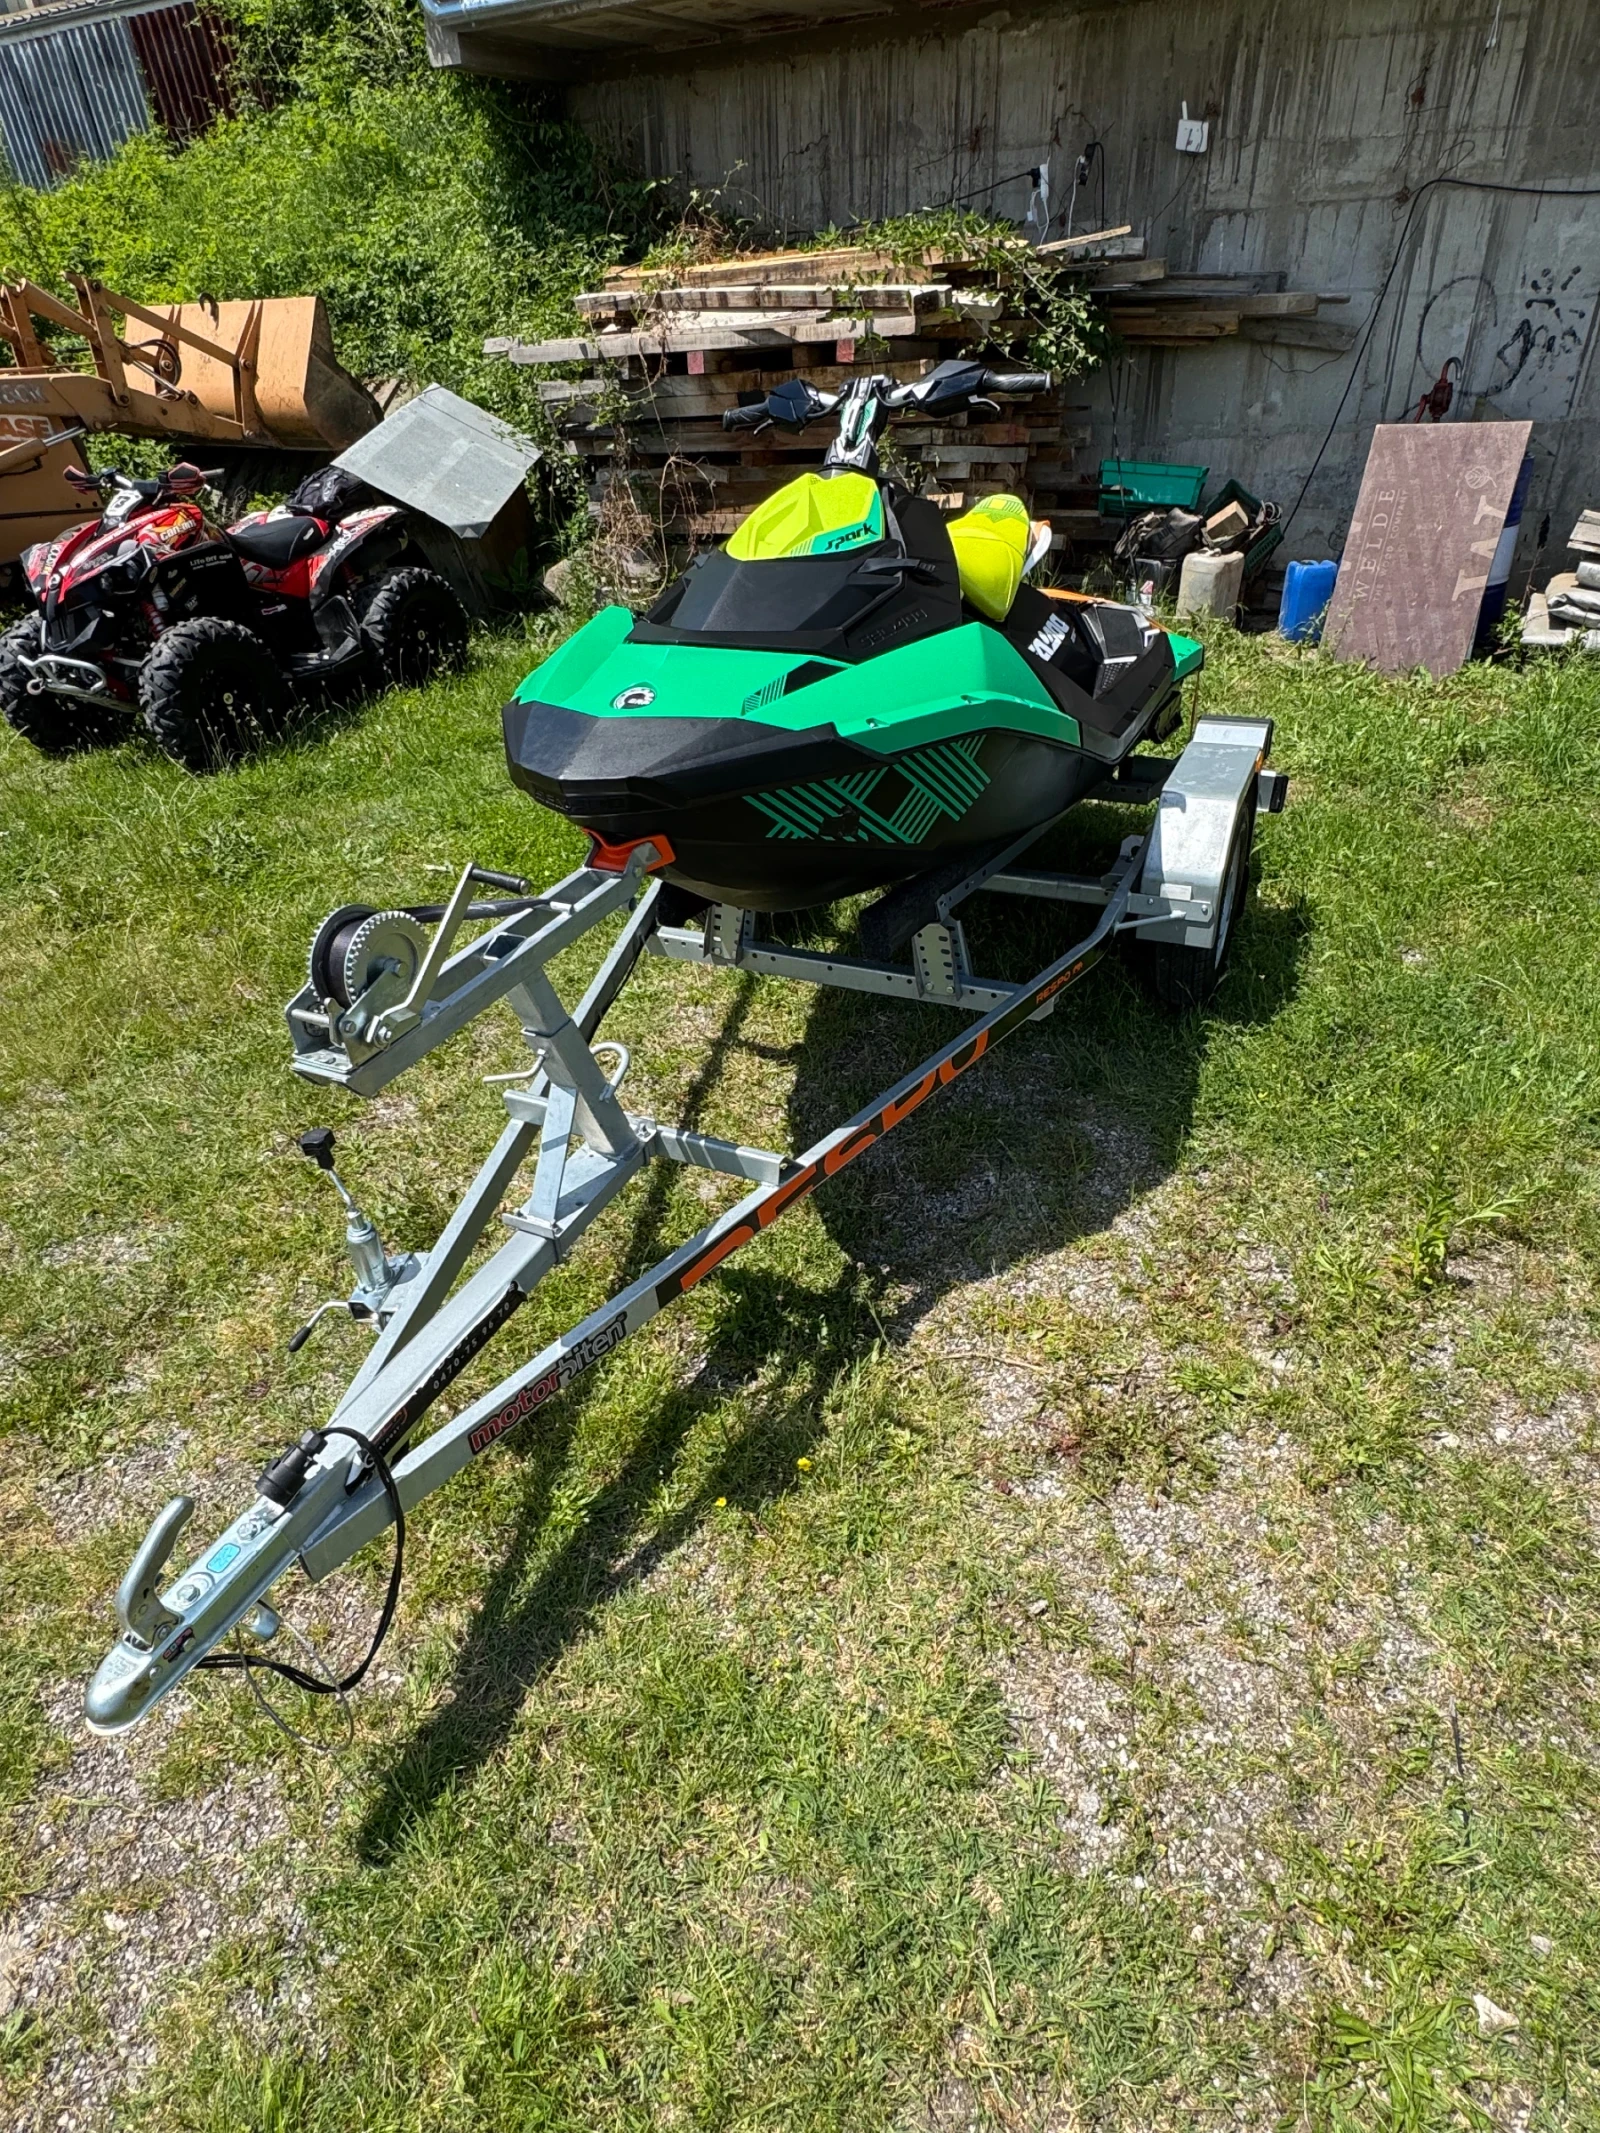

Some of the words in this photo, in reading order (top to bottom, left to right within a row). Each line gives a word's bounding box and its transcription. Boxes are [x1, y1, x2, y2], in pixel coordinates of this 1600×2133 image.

[1353, 489, 1396, 601] WELDE
[1379, 545, 1394, 578] WOOD
[1390, 489, 1409, 539] COMPANY
[1036, 970, 1071, 1005] RESPO
[481, 1321, 495, 1336] 96
[498, 1301, 511, 1317] 70
